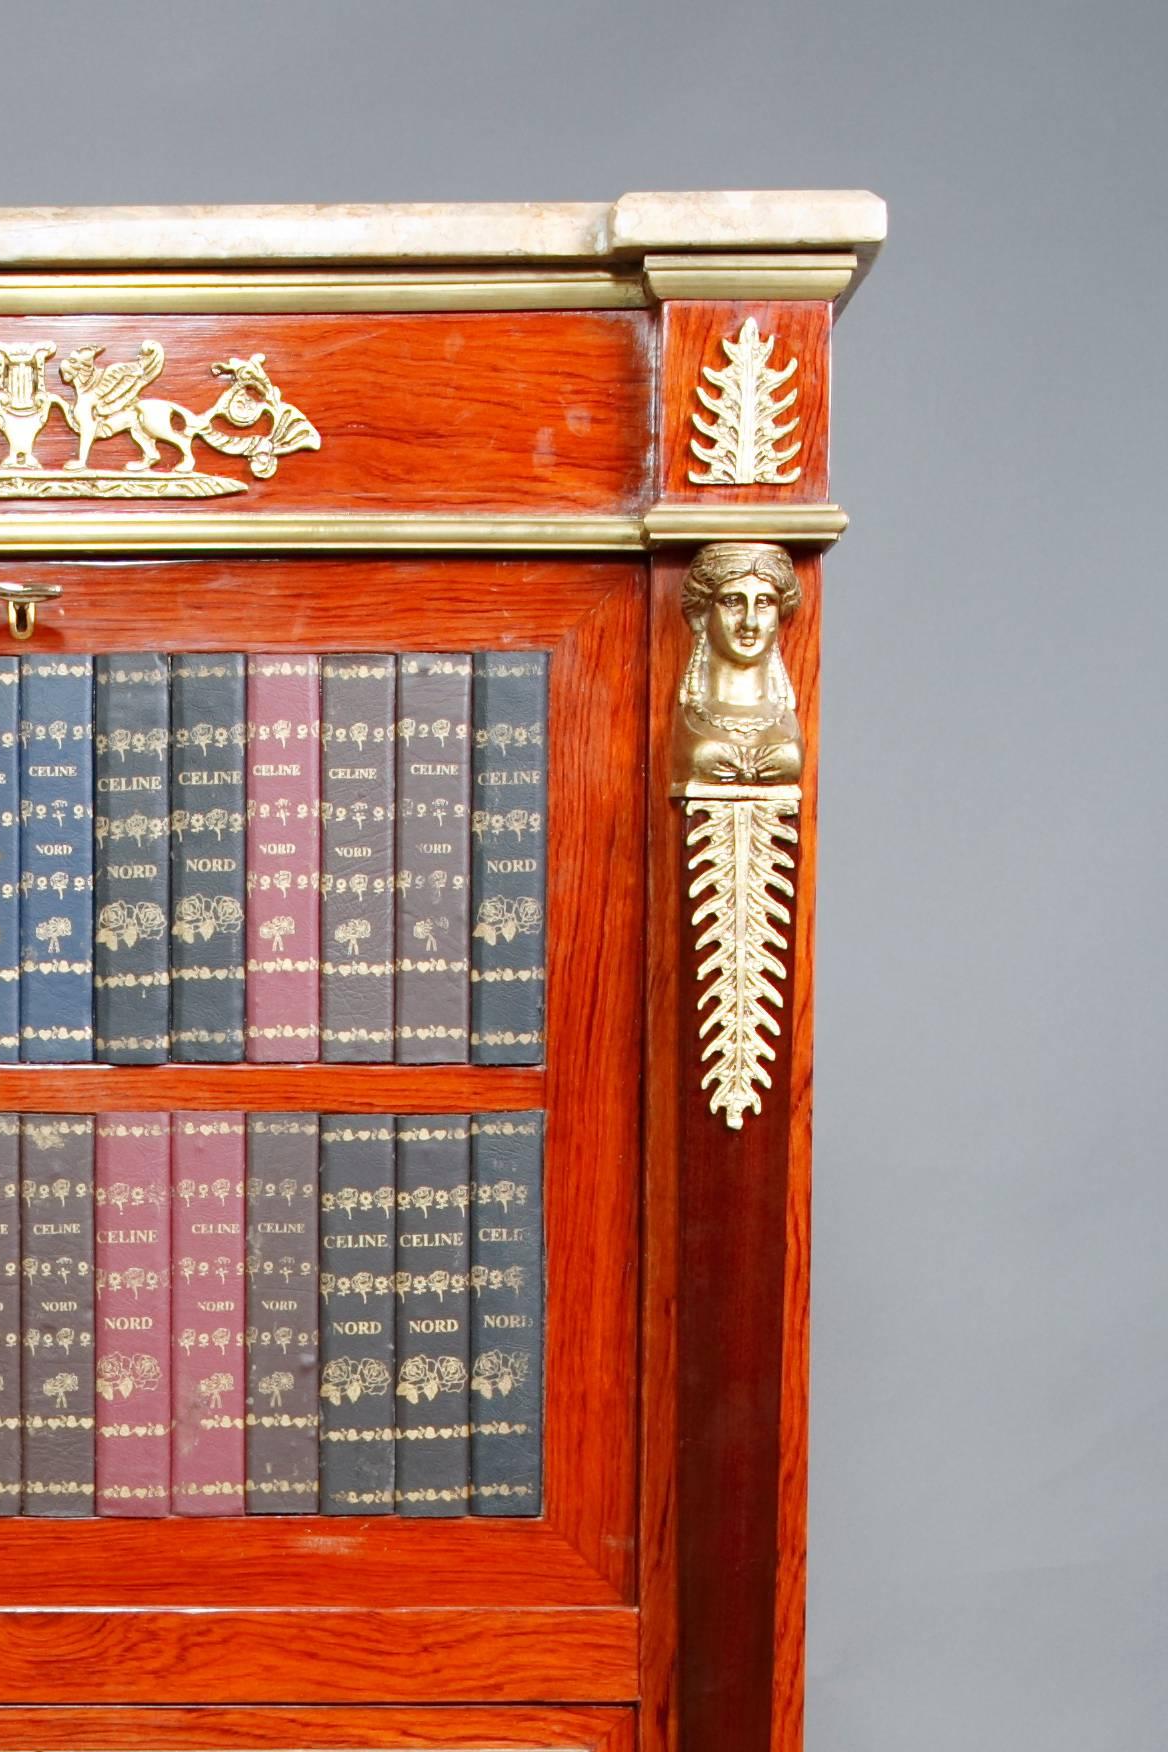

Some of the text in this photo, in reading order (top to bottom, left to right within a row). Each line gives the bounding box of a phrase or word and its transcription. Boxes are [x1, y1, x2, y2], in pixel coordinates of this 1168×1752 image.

[29, 765, 77, 777] CELINE
[253, 764, 301, 777] CELINE
[329, 768, 376, 780] CELINE
[410, 763, 458, 776] CELINE
[98, 776, 162, 791] CELINE
[178, 771, 242, 785] CELINE
[36, 843, 72, 856] NORD
[260, 843, 295, 855] NORD
[335, 846, 371, 858] NORD
[107, 864, 157, 880] NORD
[186, 858, 236, 873] NORD
[487, 859, 536, 874] NORD
[33, 1223, 80, 1235] CELINE
[192, 1223, 240, 1235] CELINE
[258, 1222, 305, 1234] CELINE
[97, 1229, 158, 1244] CELINE
[324, 1233, 388, 1248] CELINE
[400, 1231, 463, 1246] CELINE
[41, 1300, 77, 1312] NORD
[198, 1301, 234, 1312] NORD
[261, 1300, 297, 1312] NORD
[105, 1316, 152, 1330] NORD
[334, 1320, 382, 1335] NORD
[409, 1318, 458, 1334] NORD
